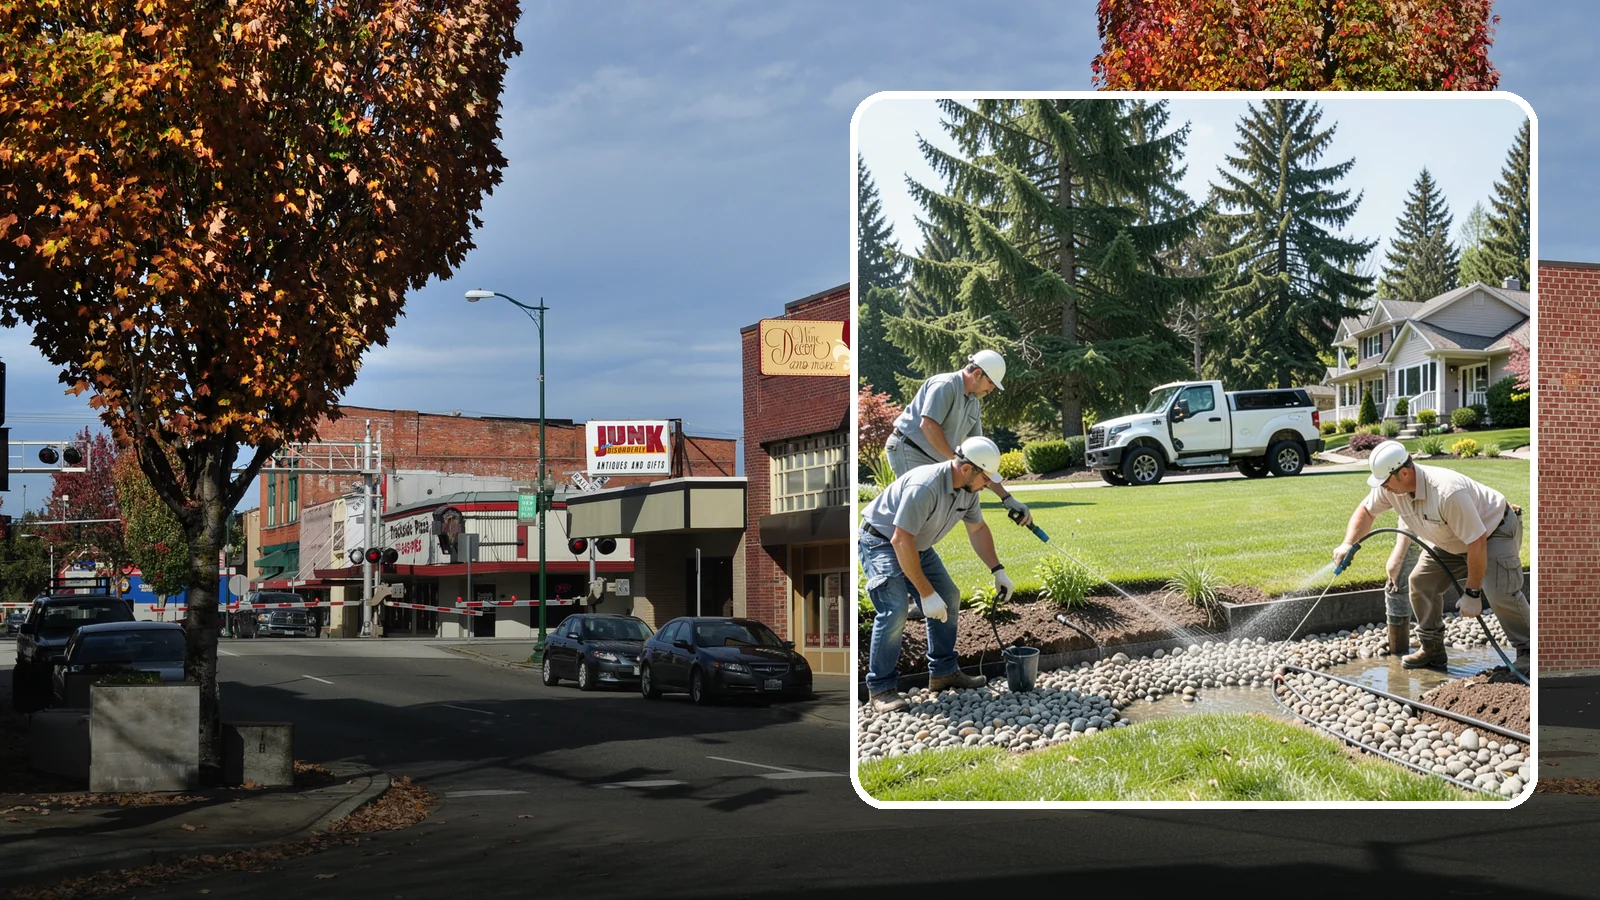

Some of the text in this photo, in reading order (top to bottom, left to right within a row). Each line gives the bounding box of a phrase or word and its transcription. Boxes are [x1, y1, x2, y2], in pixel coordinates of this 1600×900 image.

[595, 425, 665, 457] JUNK
[607, 446, 646, 454] DISORDERLY
[596, 460, 666, 470] ANTIQUES AND GIFTS
[414, 519, 429, 534] Pizza
